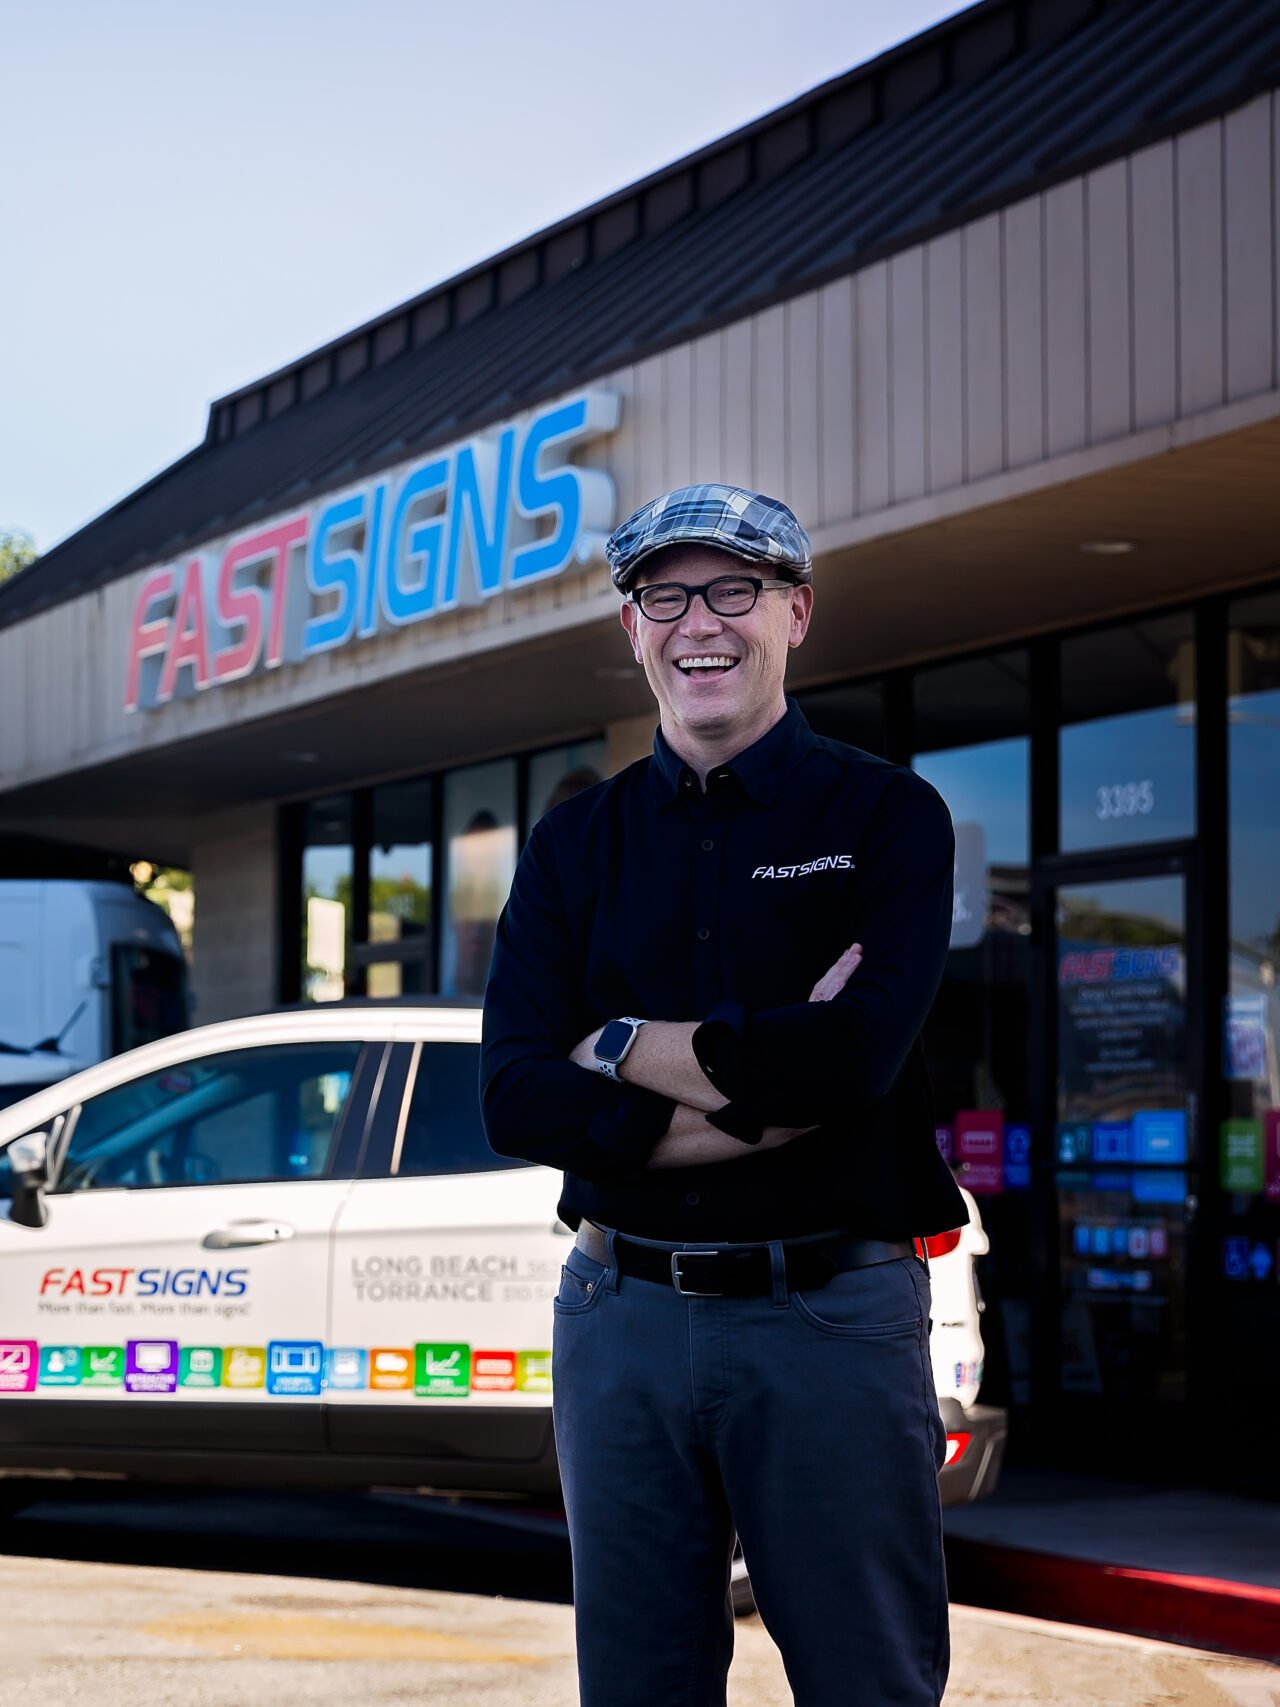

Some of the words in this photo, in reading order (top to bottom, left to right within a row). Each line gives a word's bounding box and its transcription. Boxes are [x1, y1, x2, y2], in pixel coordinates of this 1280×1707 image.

[123, 392, 596, 713] FASTSIGNS
[751, 855, 856, 879] FASTSIGNS
[351, 1255, 423, 1277] LONG
[430, 1255, 518, 1277] BEACH
[38, 1268, 250, 1297] FASTSIGNS
[353, 1281, 494, 1302] TORRANCE
